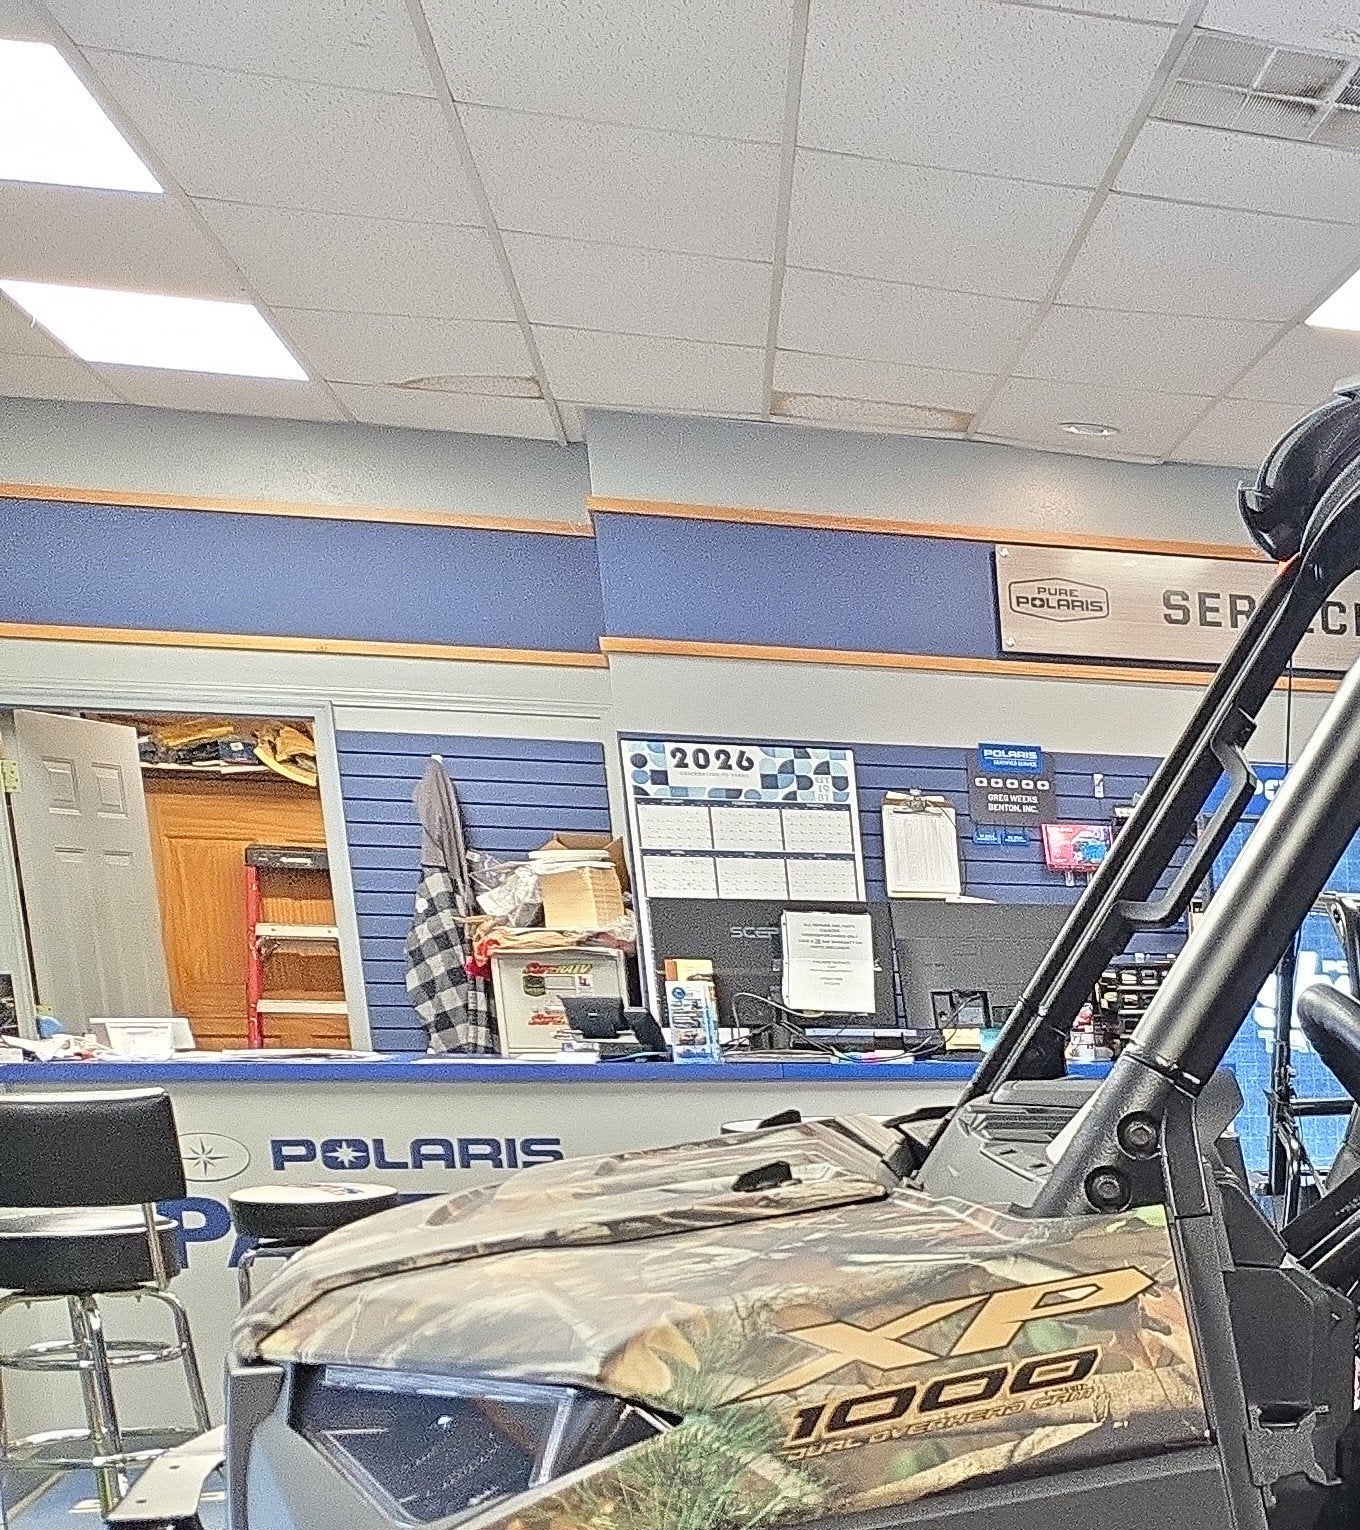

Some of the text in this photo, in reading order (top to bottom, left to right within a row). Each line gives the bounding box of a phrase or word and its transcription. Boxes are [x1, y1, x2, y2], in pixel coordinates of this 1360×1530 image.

[1015, 595, 1105, 612] POLARIS
[1036, 586, 1079, 598] PURE
[669, 746, 755, 772] 2026
[983, 749, 1038, 760] POLARIS
[271, 1137, 564, 1170] POLARIS
[717, 1265, 1157, 1403] XP
[784, 1345, 1102, 1445] 1000
[869, 1398, 1026, 1443] OVERHEAD
